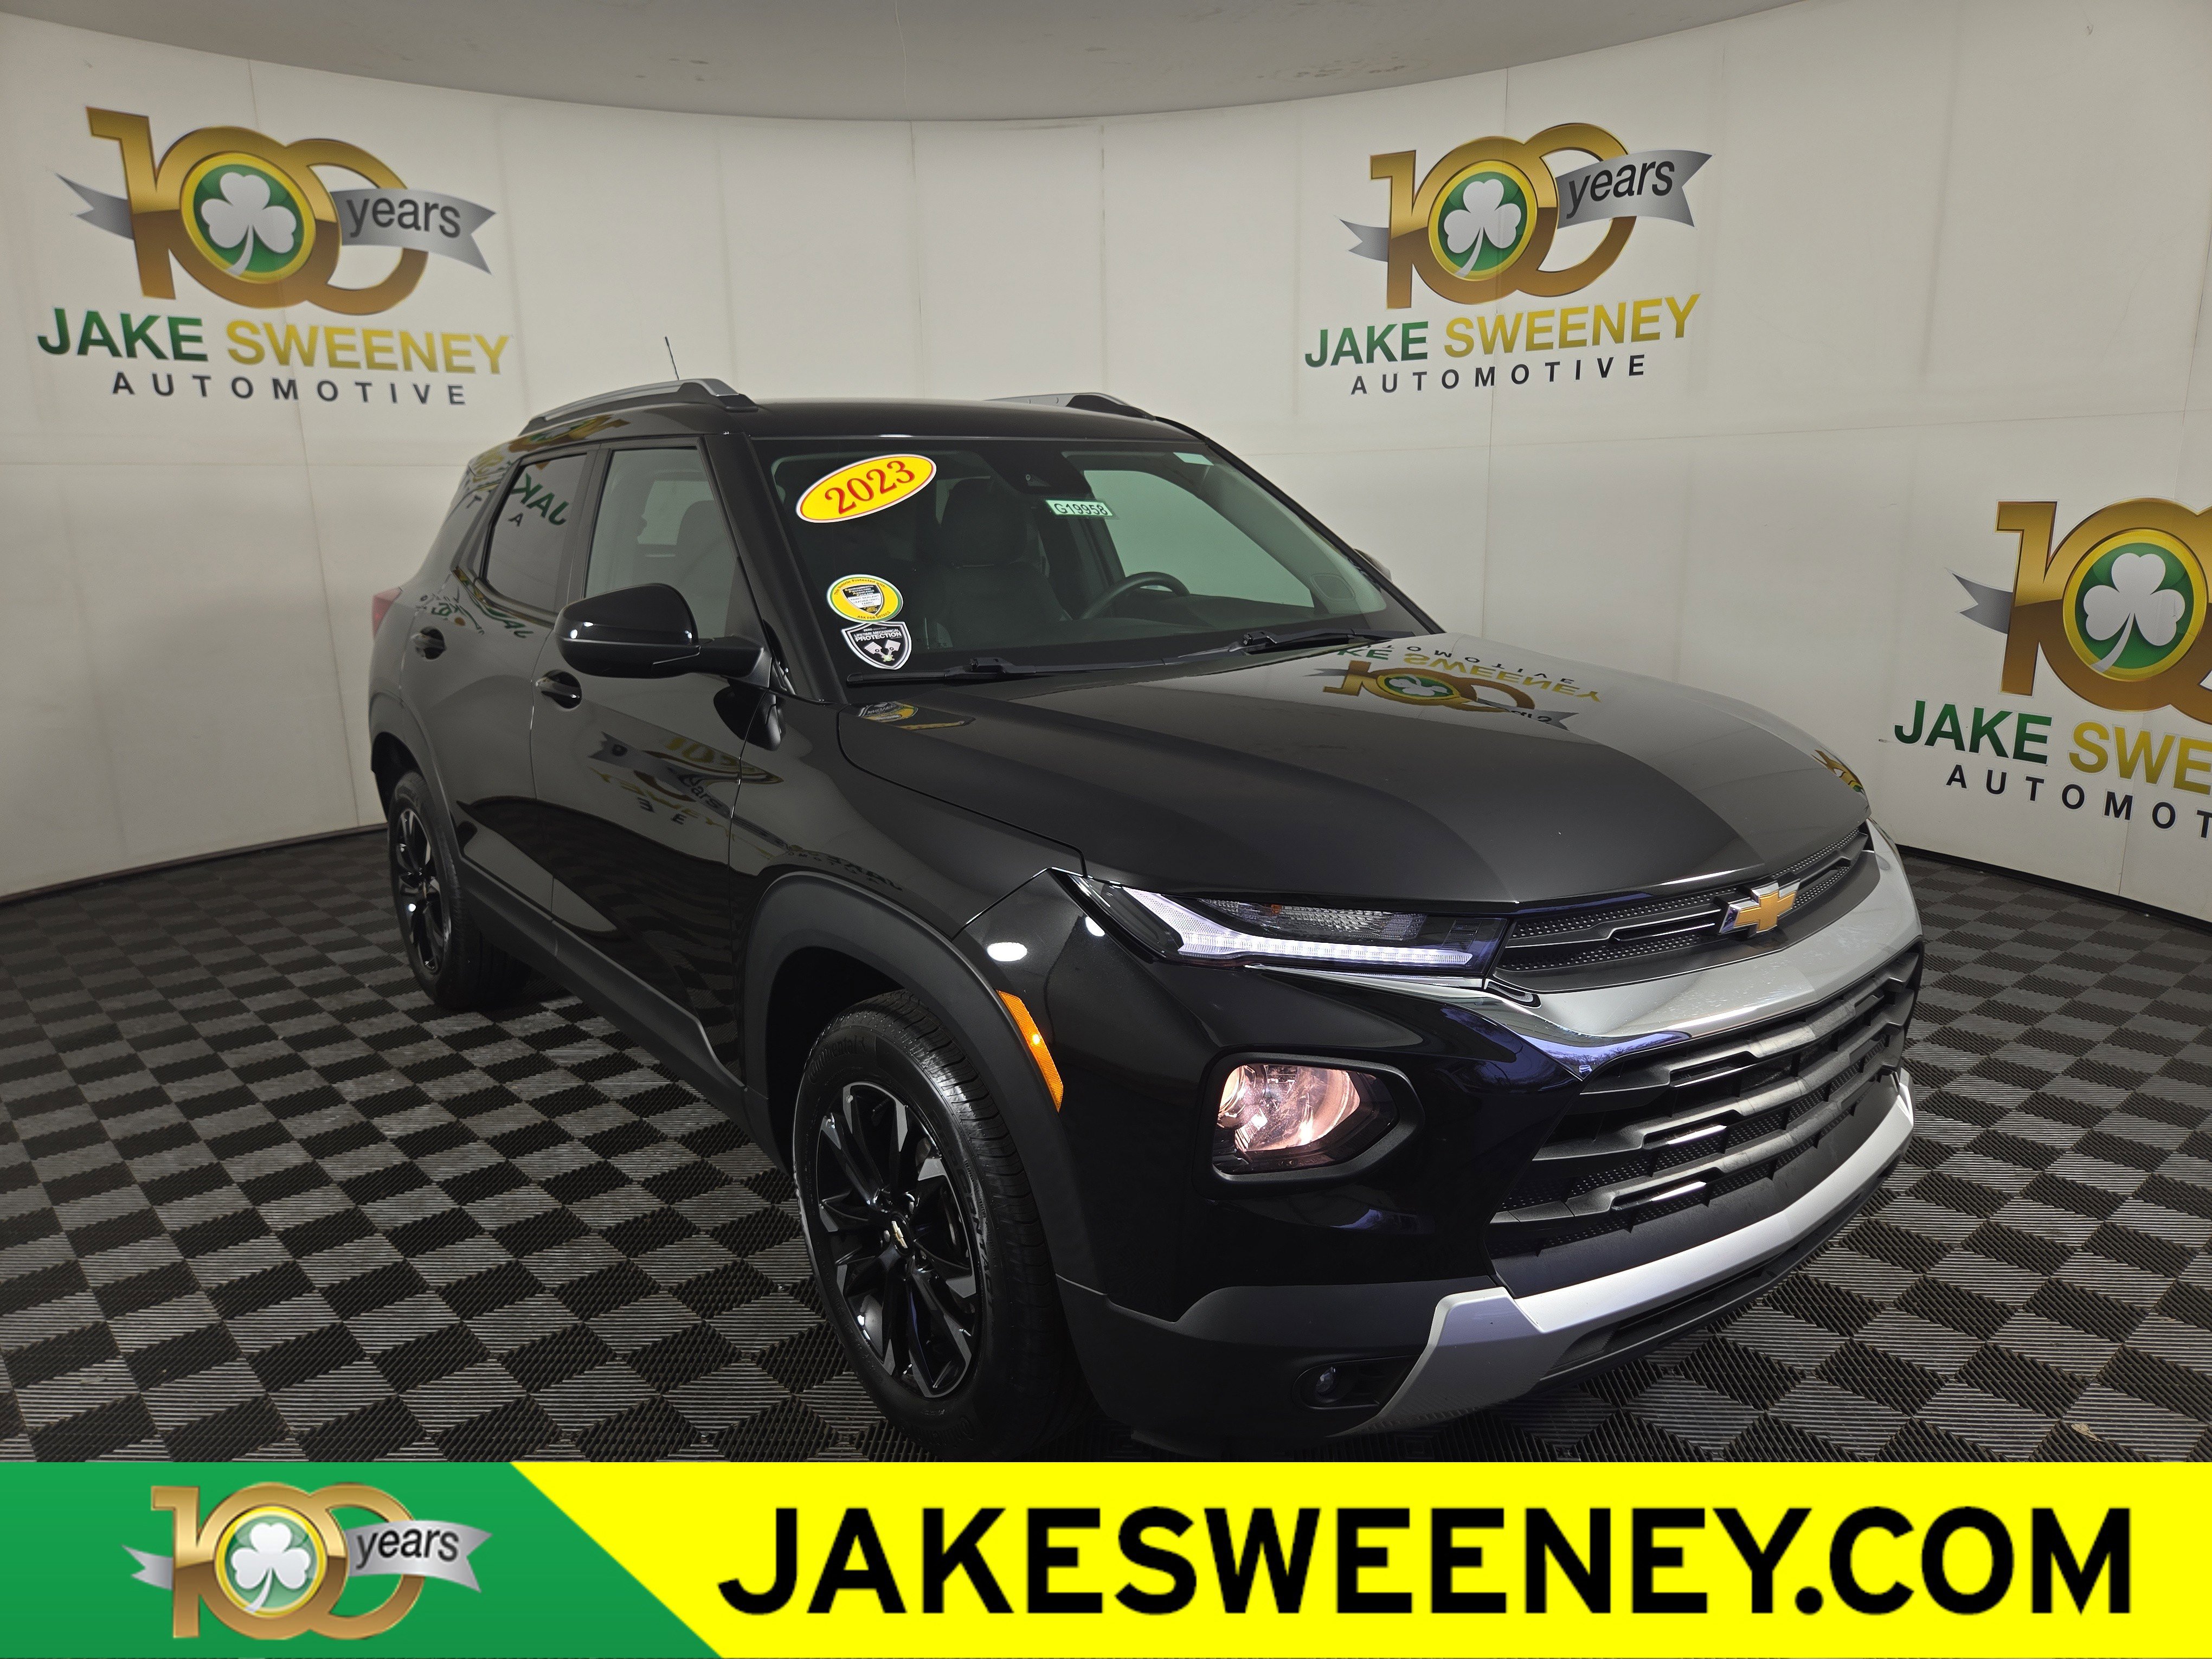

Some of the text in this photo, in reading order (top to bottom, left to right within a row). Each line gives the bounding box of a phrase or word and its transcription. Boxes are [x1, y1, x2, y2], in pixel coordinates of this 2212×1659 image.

[1566, 159, 1674, 219] years
[346, 196, 461, 237] years
[37, 306, 510, 374] JAKE SWEENEY
[1305, 293, 1700, 367] JAKE SWEENEY
[112, 372, 466, 405] AUTOMOTIVE
[1351, 354, 1645, 395] AUTOMOTIVE
[825, 460, 915, 514] 2023
[1054, 503, 1108, 515] G19958
[855, 631, 902, 642] PROTECTION
[1996, 497, 2212, 725] 10
[1894, 699, 2053, 765] JAKE
